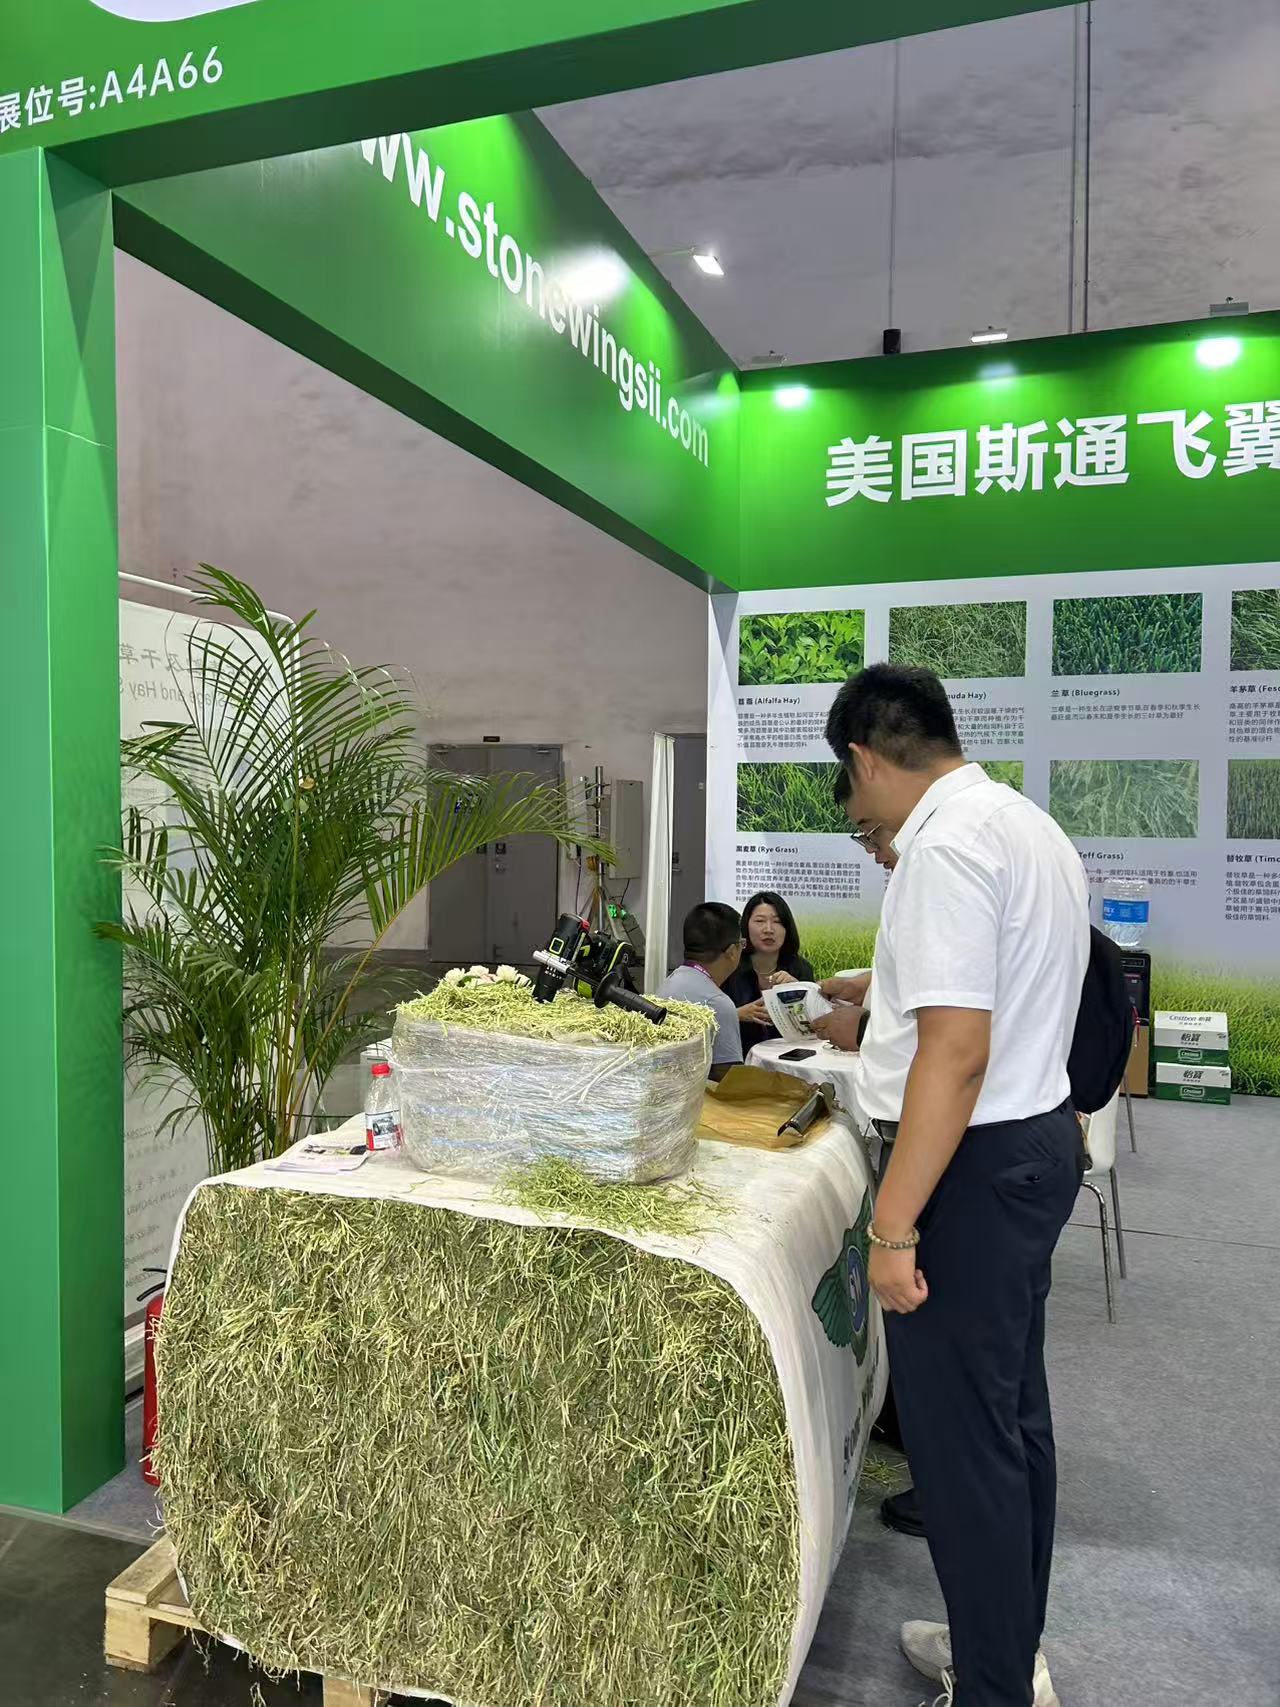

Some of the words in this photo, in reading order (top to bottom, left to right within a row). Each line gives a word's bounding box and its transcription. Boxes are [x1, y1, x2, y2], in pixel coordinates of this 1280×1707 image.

[825, 400, 1280, 507] 美国斯通飞翼
[967, 691, 987, 700] Hay)
[1071, 688, 1120, 698] (Bluegrass)
[783, 697, 801, 705] Hay)
[757, 846, 774, 854] (Rye
[775, 846, 799, 854] Grass)
[1096, 851, 1124, 860] Grass)
